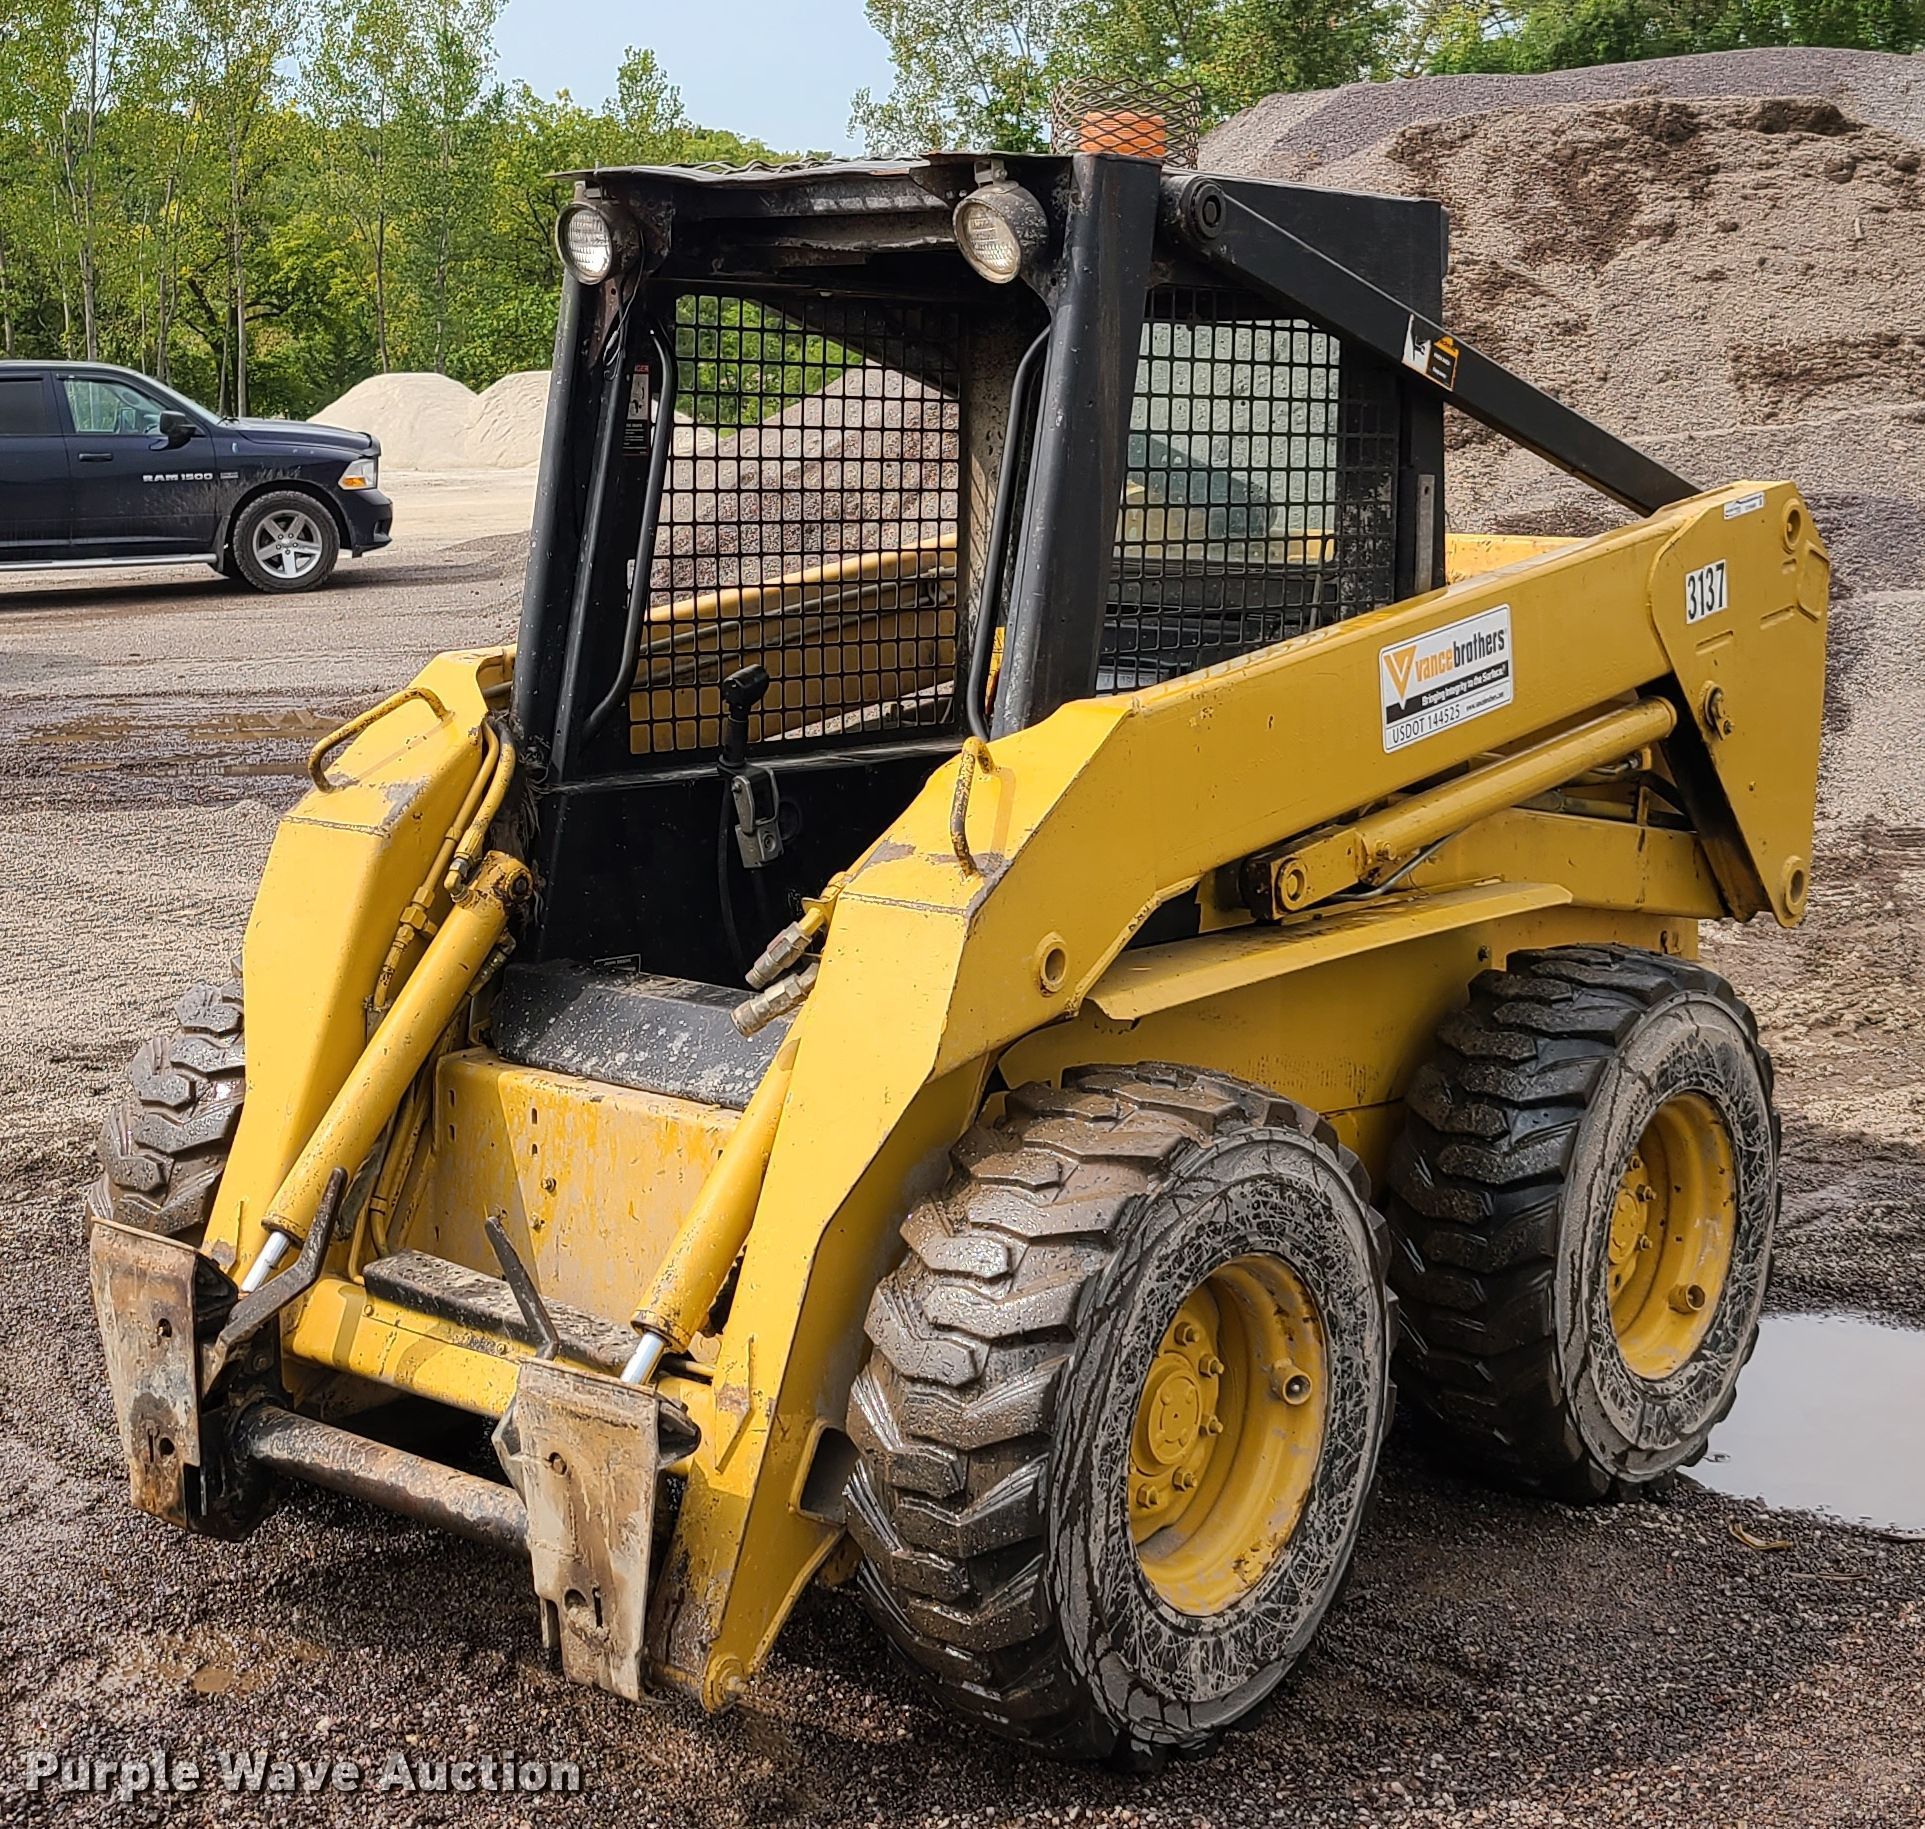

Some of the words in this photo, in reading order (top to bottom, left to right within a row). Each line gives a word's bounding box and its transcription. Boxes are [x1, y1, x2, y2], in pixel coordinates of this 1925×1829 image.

[143, 474, 178, 482] RAM
[181, 472, 213, 480] 1500
[1687, 562, 1725, 620] 3137
[1392, 717, 1425, 743] USDOT
[1428, 704, 1460, 730] 144525
